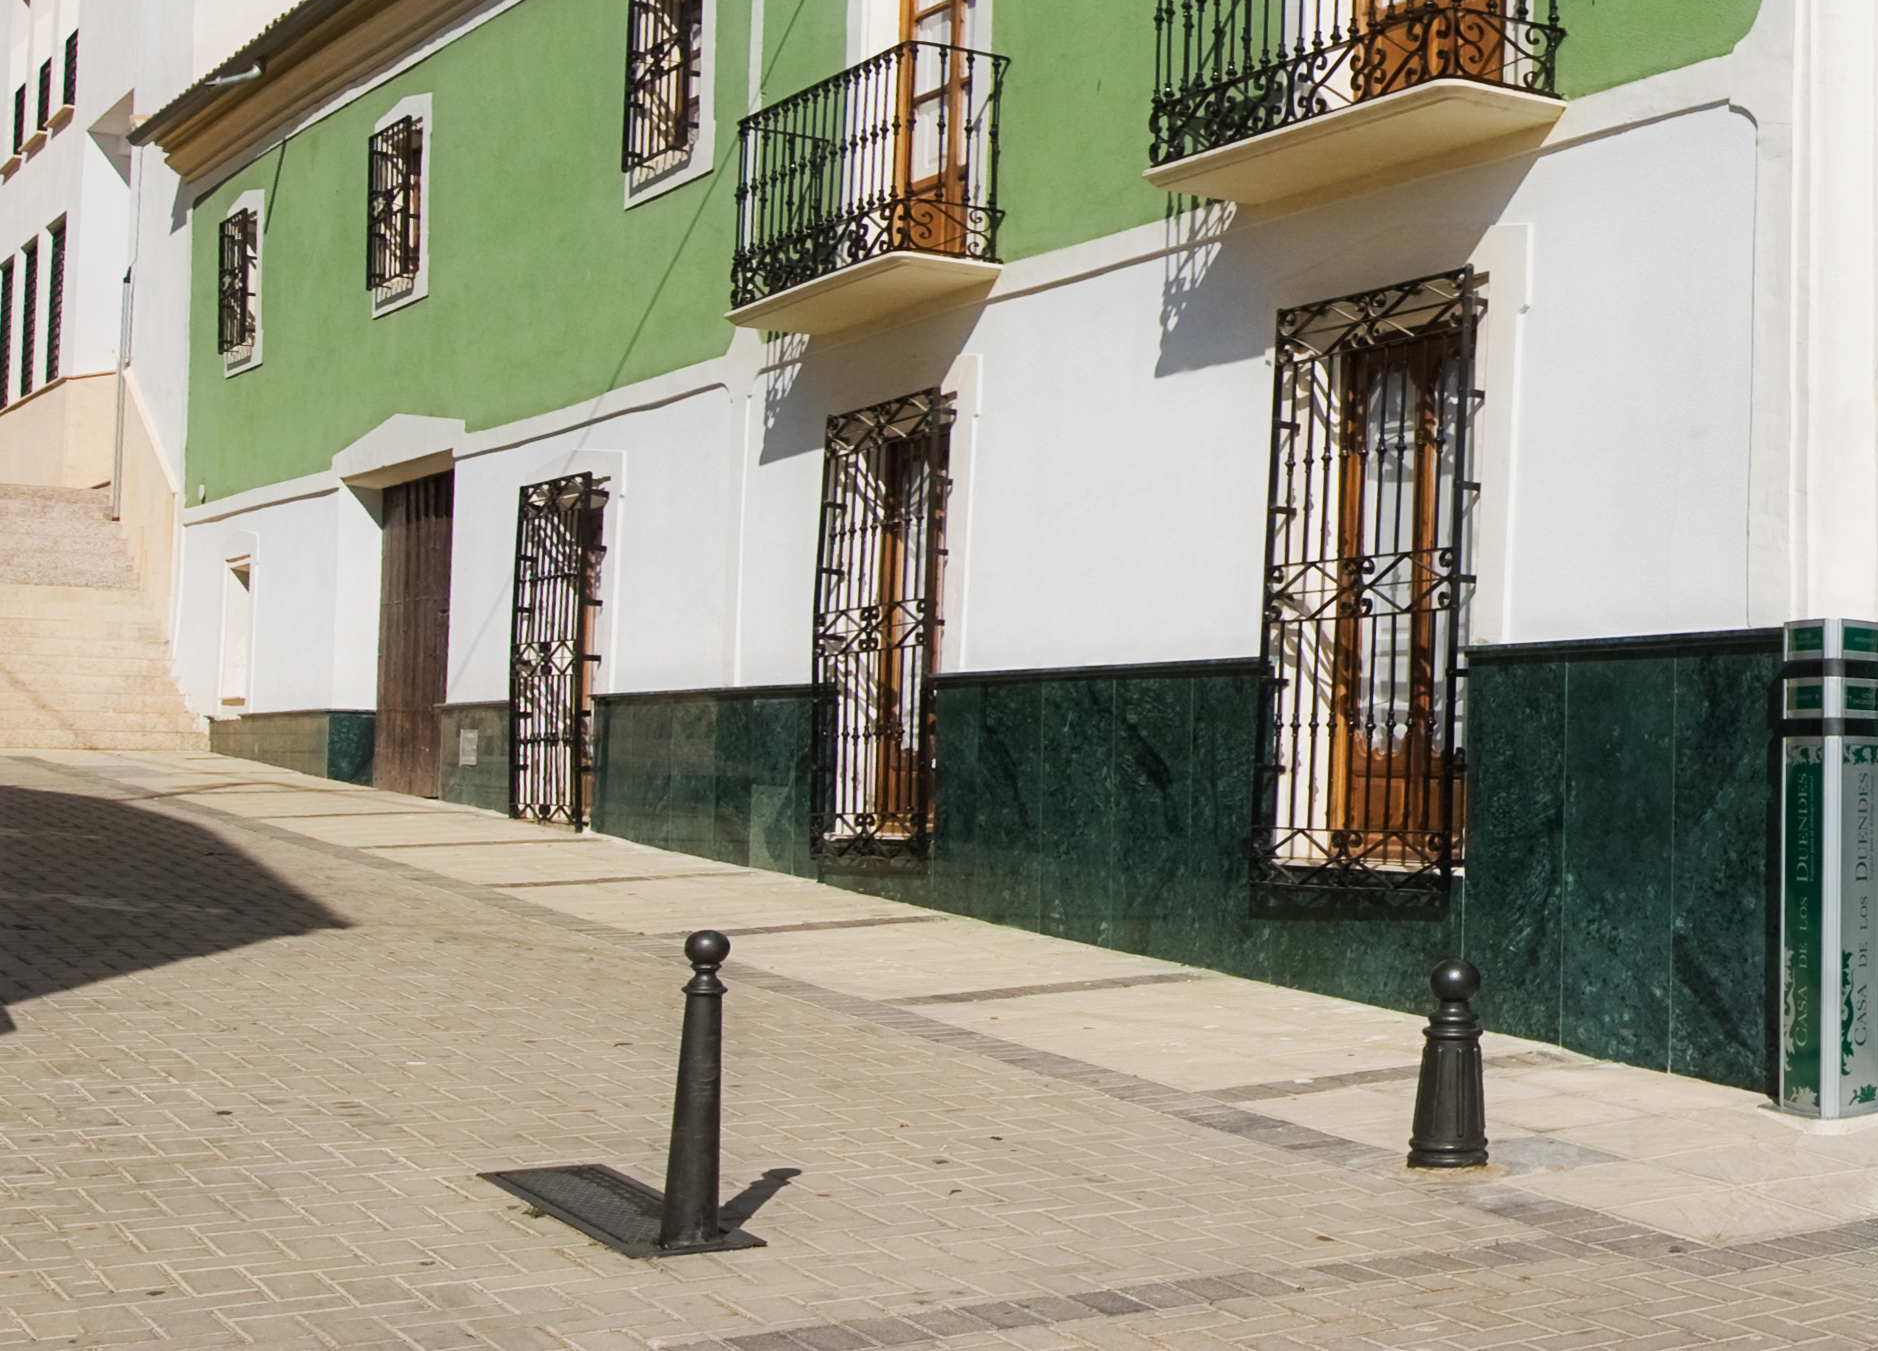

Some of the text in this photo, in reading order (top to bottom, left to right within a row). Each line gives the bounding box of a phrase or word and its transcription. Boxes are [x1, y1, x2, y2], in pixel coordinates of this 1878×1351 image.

[1794, 772, 1809, 1047] CASA DE LOS DUENDES
[1853, 772, 1869, 1047] CASA DE LOS DUENDES
